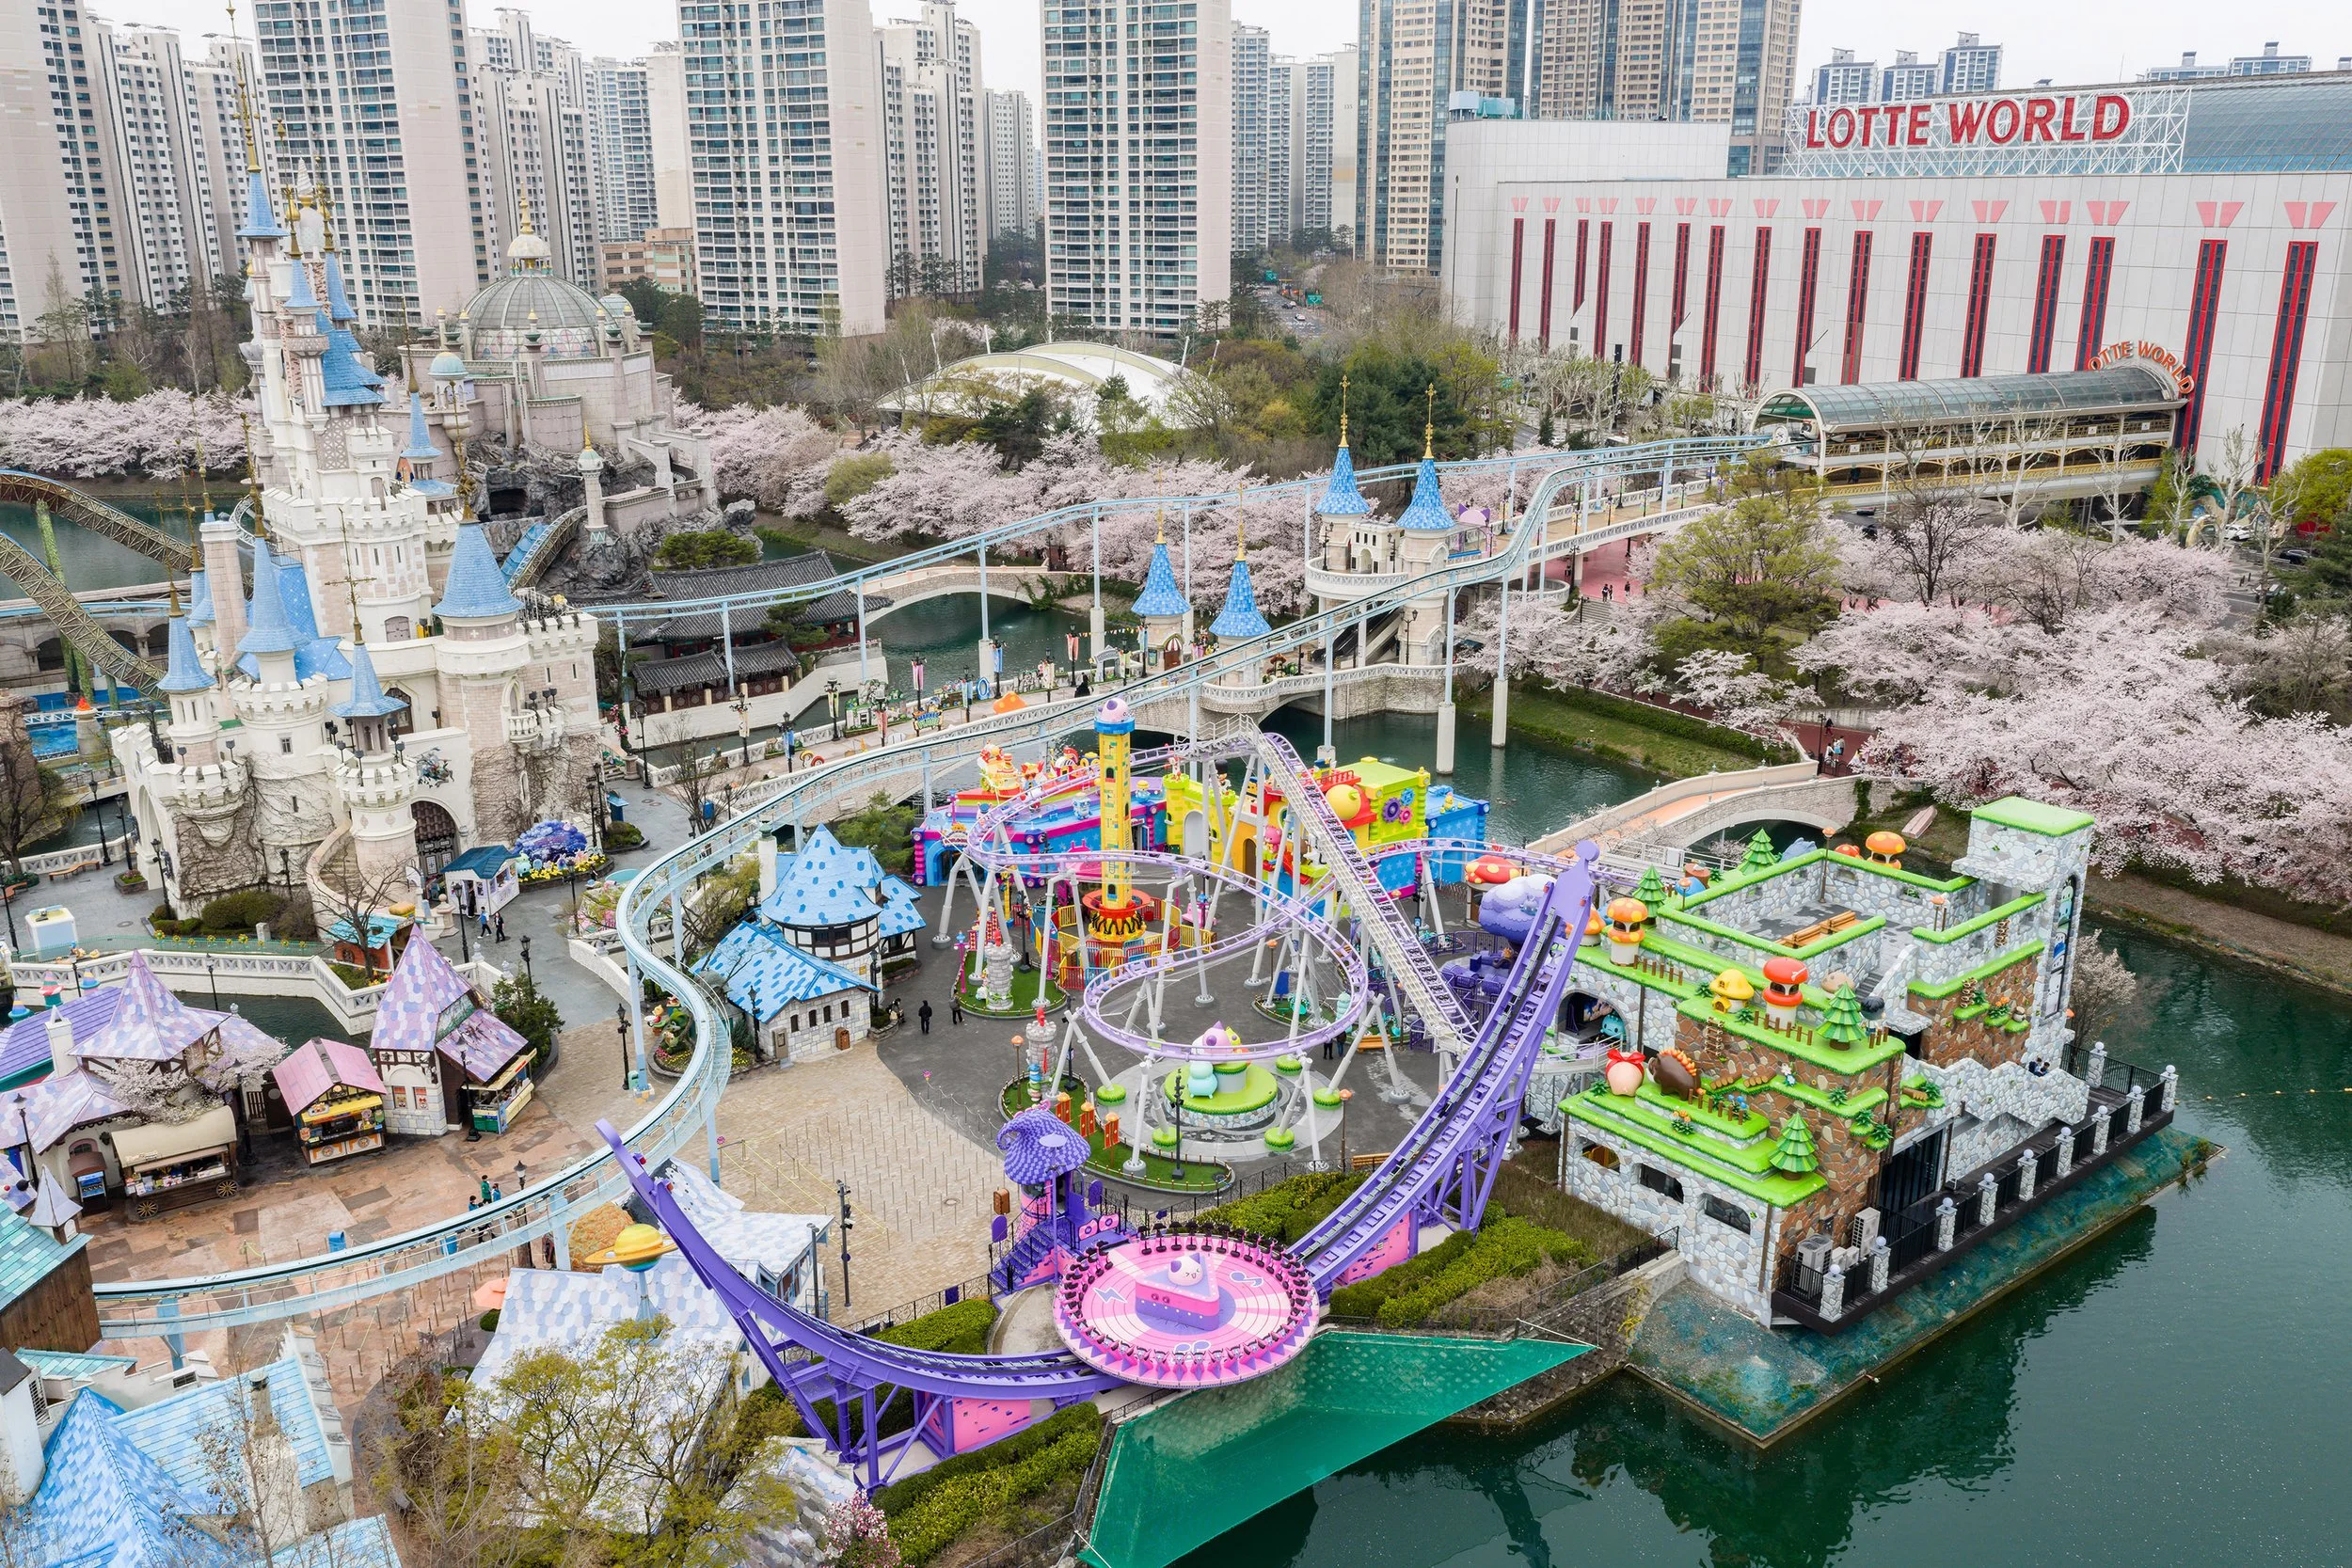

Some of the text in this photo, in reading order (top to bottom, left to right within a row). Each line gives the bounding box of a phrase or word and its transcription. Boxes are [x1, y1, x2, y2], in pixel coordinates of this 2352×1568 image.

[1806, 95, 2130, 149] LOTTE WORLD
[2089, 340, 2194, 394] OTTE WORLD
